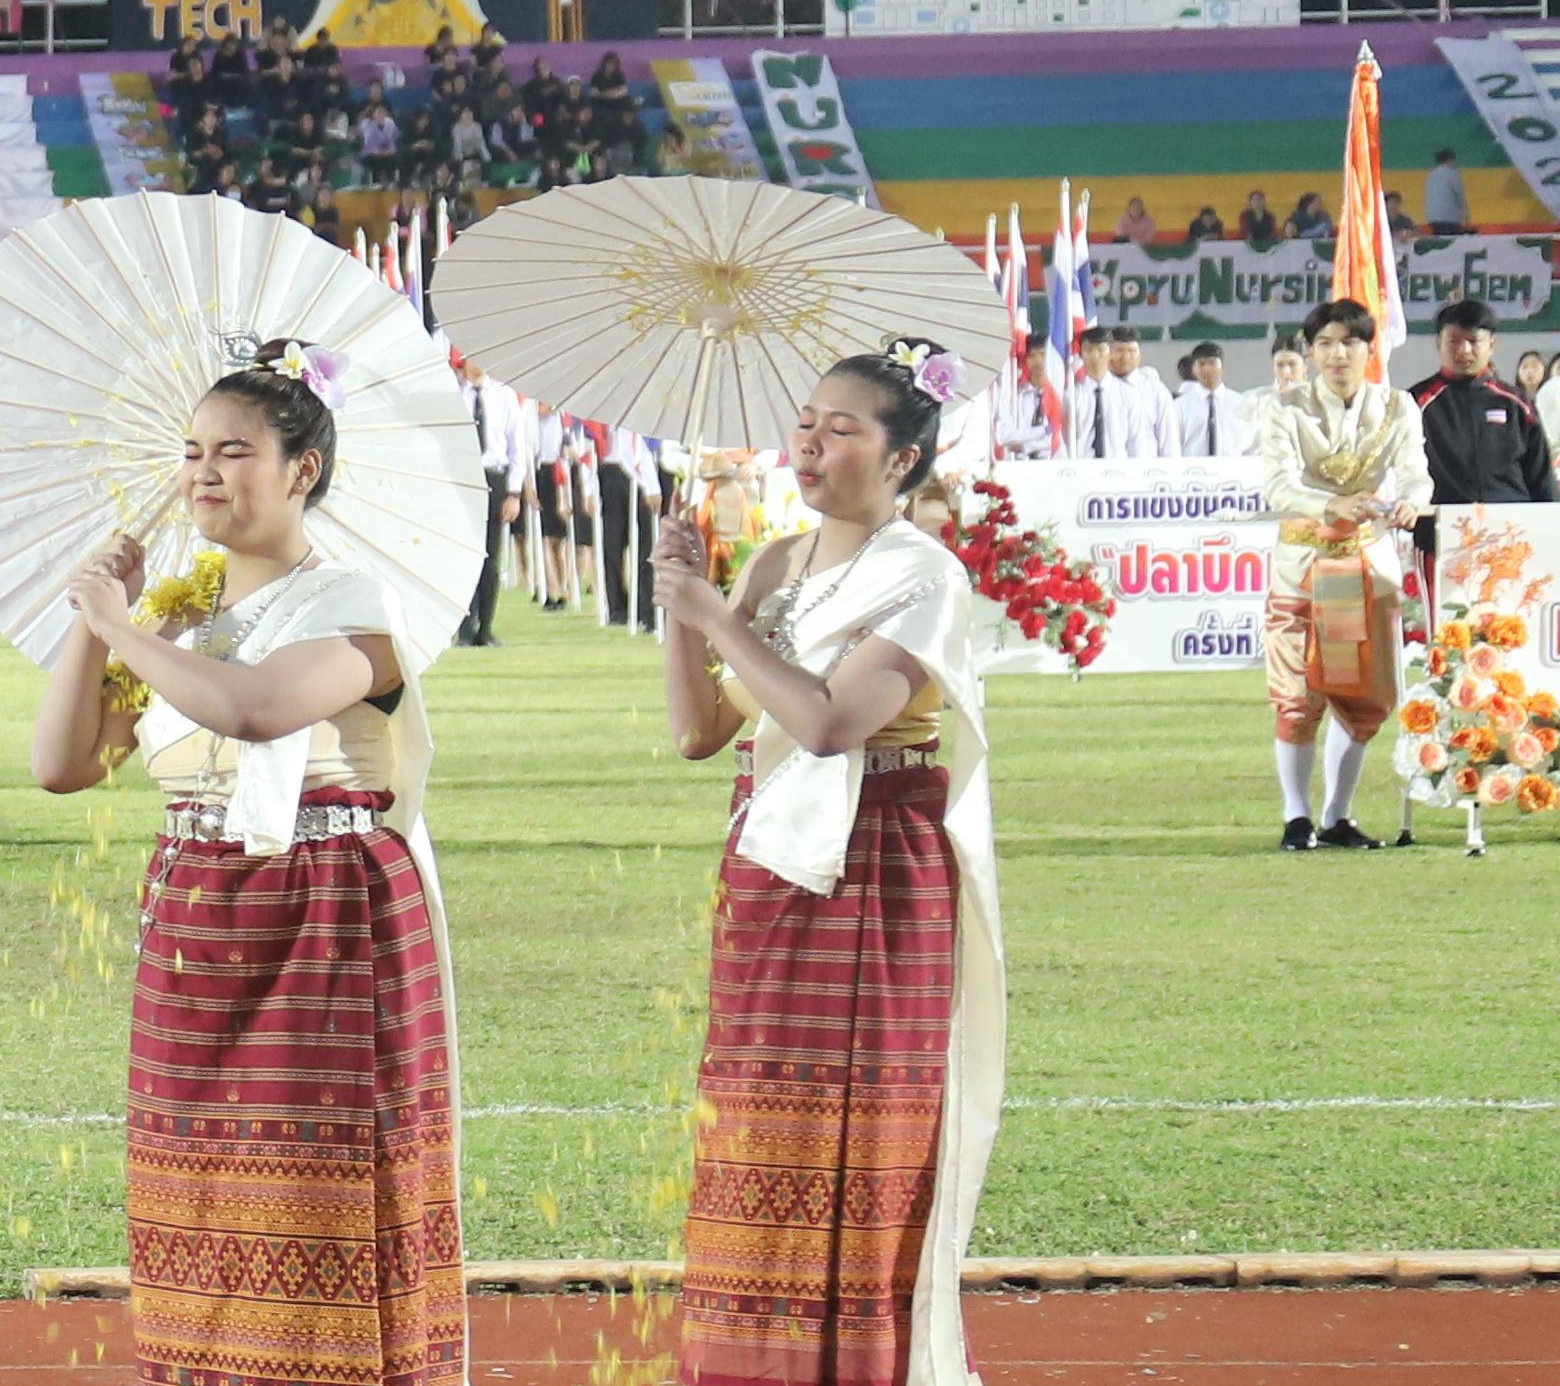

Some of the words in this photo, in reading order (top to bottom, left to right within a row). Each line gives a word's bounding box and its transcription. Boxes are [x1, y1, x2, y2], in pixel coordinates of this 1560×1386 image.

[1101, 537, 1271, 595] “ปลาบึก
[1181, 613, 1252, 657] ครั้งที่
